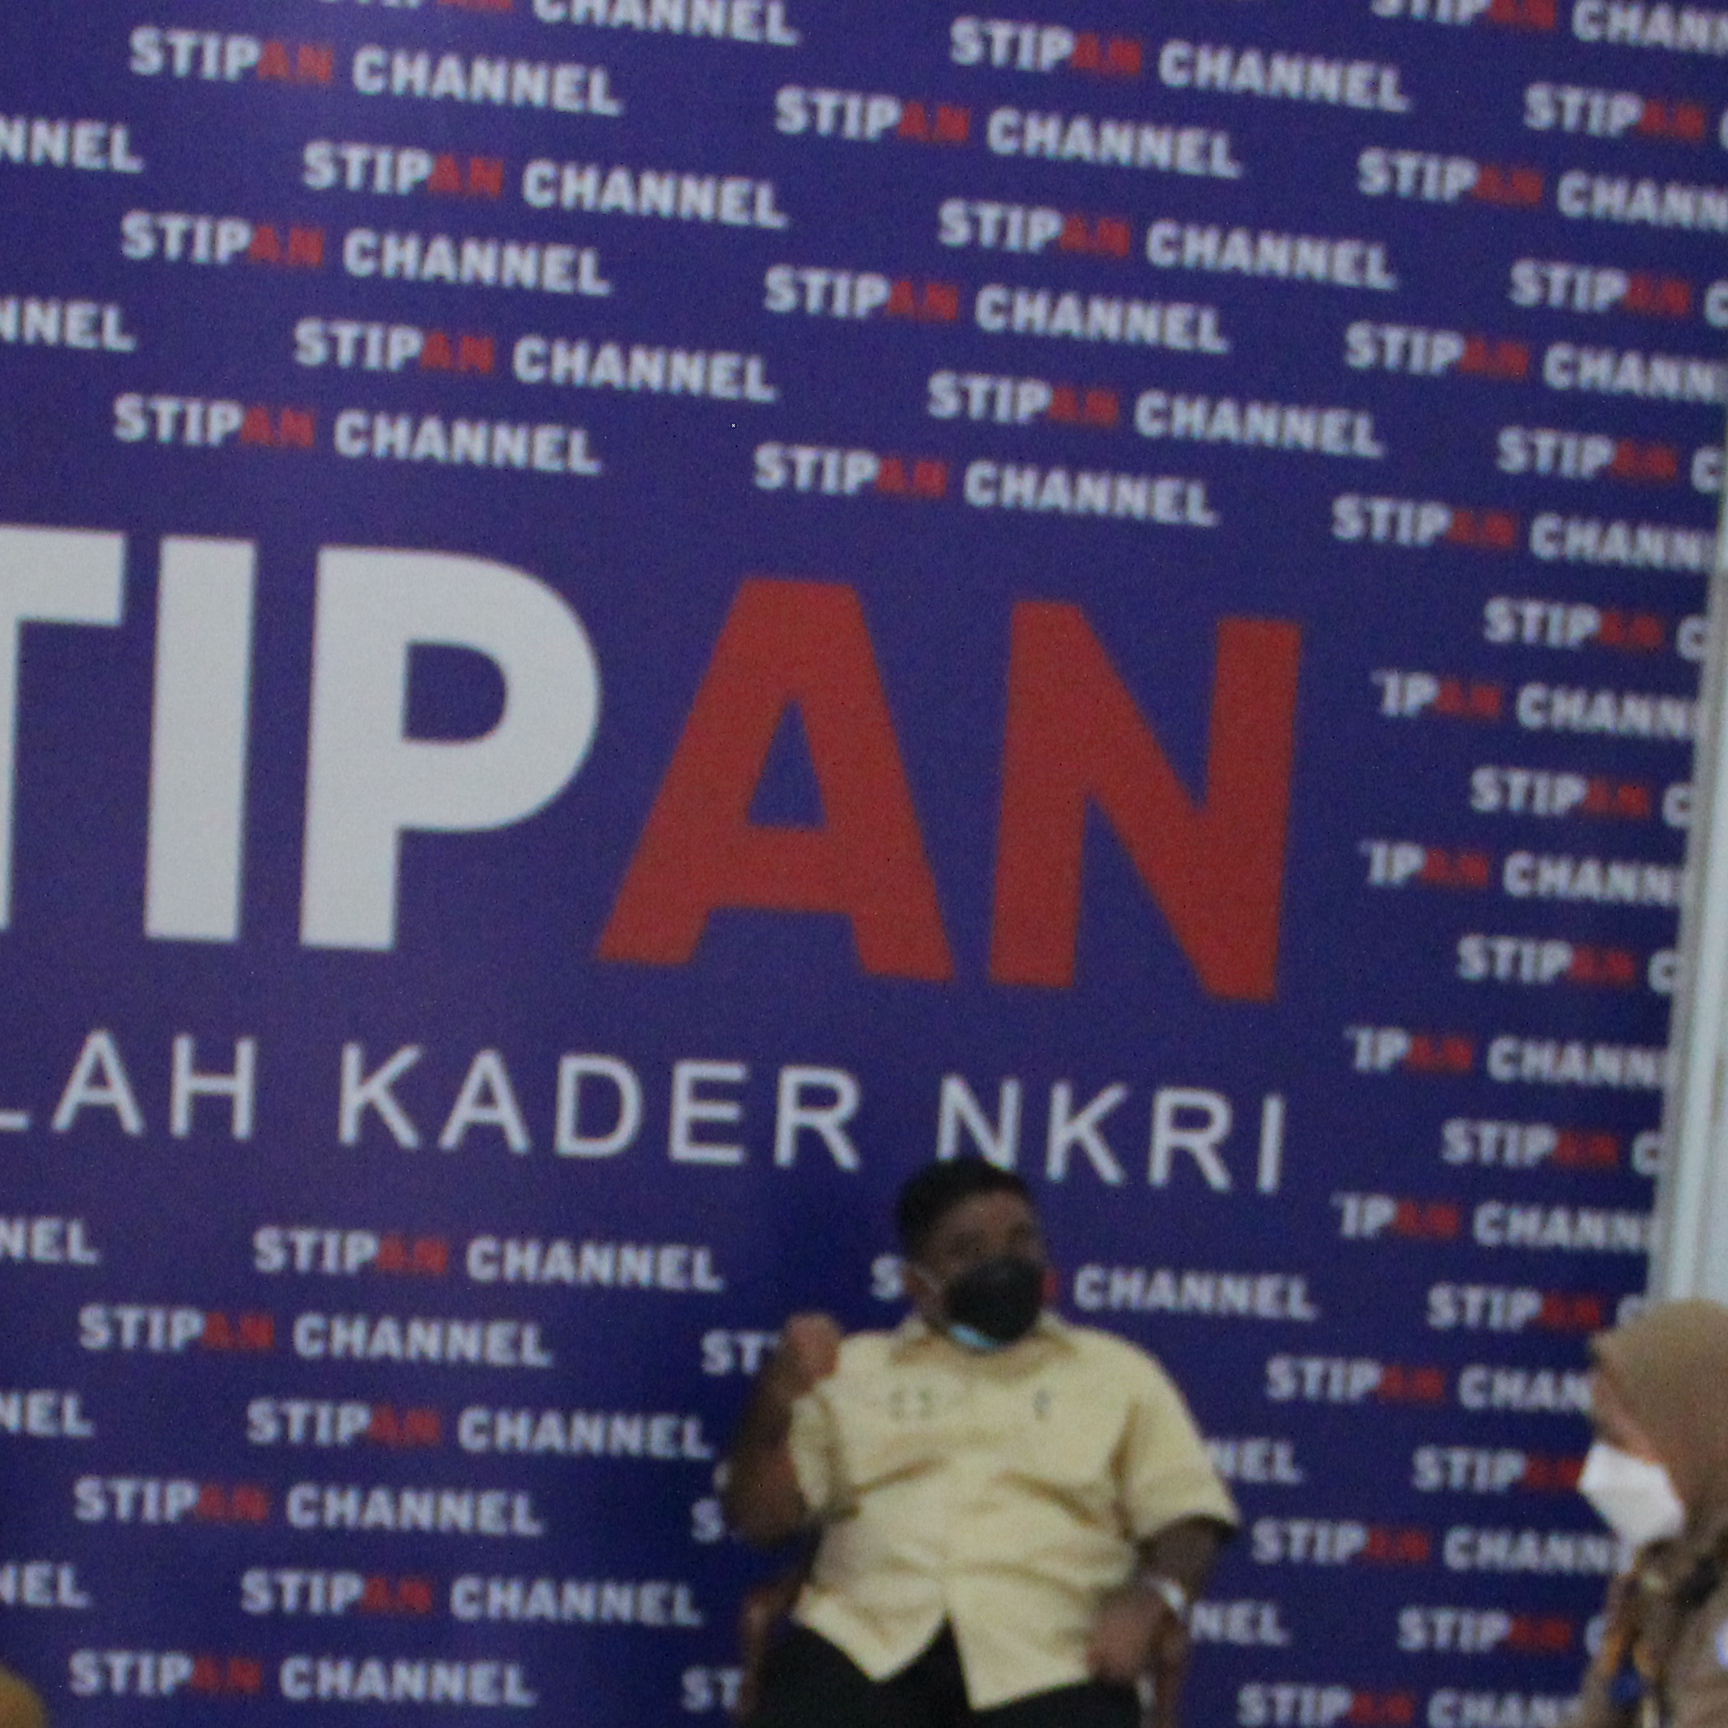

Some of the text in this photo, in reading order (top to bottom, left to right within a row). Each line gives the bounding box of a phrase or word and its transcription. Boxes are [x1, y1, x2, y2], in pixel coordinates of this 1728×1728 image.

[130, 25, 622, 116] STIPAN CHANNEL
[950, 16, 1410, 113] STIPAN CHANNEL
[775, 84, 1241, 179] STIPAN CHANNEL
[1524, 82, 1705, 138] STIPAN
[303, 139, 788, 229] STIPAN CHANNEL
[1357, 146, 1543, 203] STIPAN
[121, 209, 610, 296] STIPAN CHANNEL
[938, 198, 1396, 289] STIPAN CHANNEL
[764, 264, 1228, 352] STIPAN CHANNEL
[1510, 258, 1691, 315] STIPAN
[294, 317, 776, 402] STIPAN CHANNEL
[1345, 321, 1529, 376] STIPAN
[113, 392, 601, 475] STIPAN CHANNEL
[928, 370, 1383, 459] STIPAN CHANNEL
[1498, 425, 1677, 478] STIPAN
[754, 441, 1216, 527] STIPAN CHANNEL
[1332, 493, 1515, 547] STIPAN
[1484, 596, 1661, 647] STIPAN
[1471, 766, 1649, 816] STIPAN
[1457, 933, 1634, 983] STIPAN
[339, 1043, 860, 1171] KADER
[937, 1073, 1285, 1194] NKRI
[1442, 1118, 1617, 1166] STIPAN
[253, 1225, 720, 1291] STIPAN CHANNEL
[1073, 1264, 1316, 1320] CHANNEL
[1428, 1282, 1600, 1330] STIPAN
[79, 1304, 548, 1367] STIPAN CHANNEL
[1266, 1355, 1596, 1412] STIPAN CHAN
[246, 1398, 710, 1459] STIPAN CHANNEL
[73, 1475, 542, 1536] STIPAN CHANNEL
[1252, 1518, 1429, 1563] STIPAN
[241, 1569, 700, 1626] STIPAN CHANNEL
[1398, 1607, 1570, 1653] STIPAN
[69, 1650, 534, 1706] STIPAN CHANNEL
[1239, 1683, 1412, 1727] STIPAN
